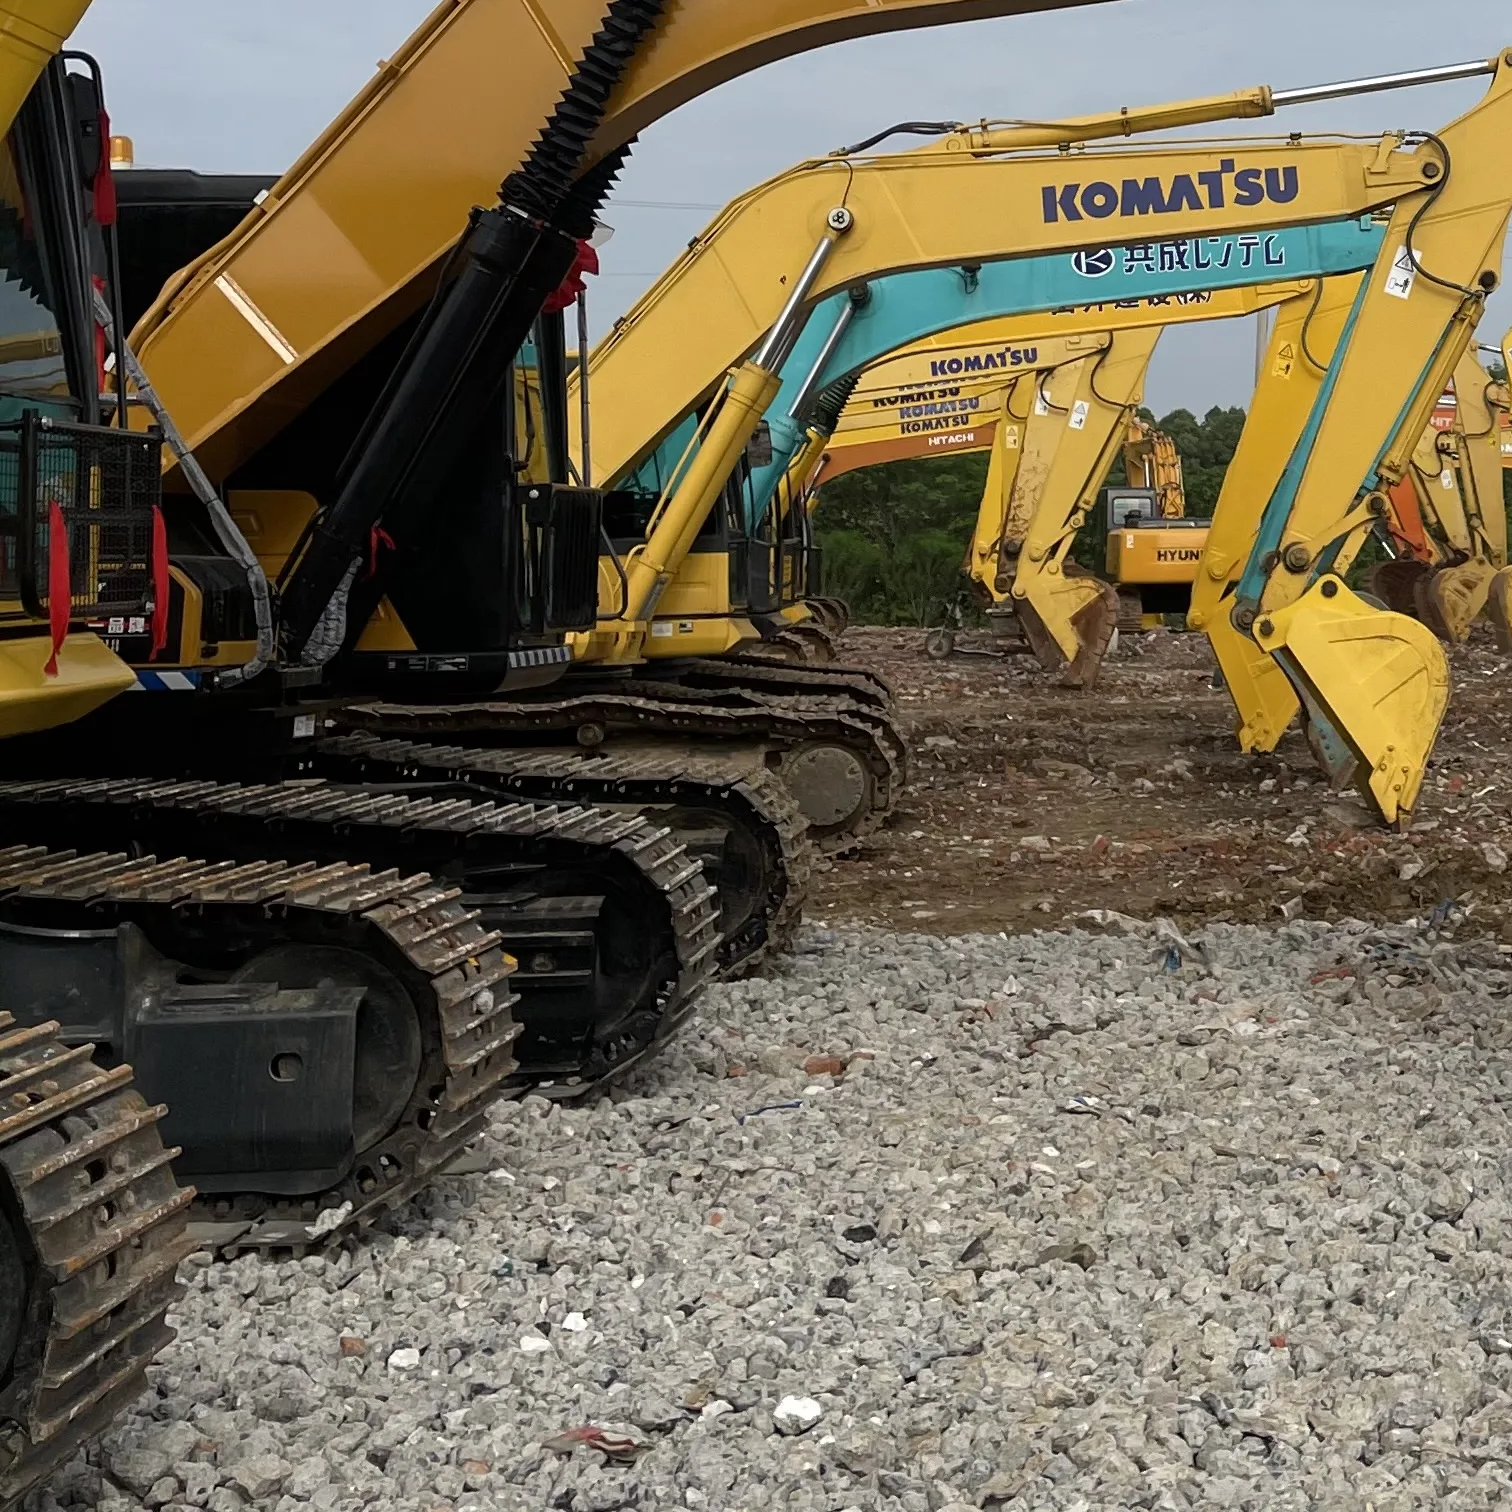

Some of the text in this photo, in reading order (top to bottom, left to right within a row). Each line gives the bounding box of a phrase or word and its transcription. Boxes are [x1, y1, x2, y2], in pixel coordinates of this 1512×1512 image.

[1041, 158, 1300, 224] KOMATSU
[930, 347, 1038, 377] KOMATSU
[900, 397, 980, 419] KOMATSU
[901, 415, 969, 434] KOMATSU
[928, 432, 974, 446] HITACHI
[1157, 549, 1203, 561] HYUN
